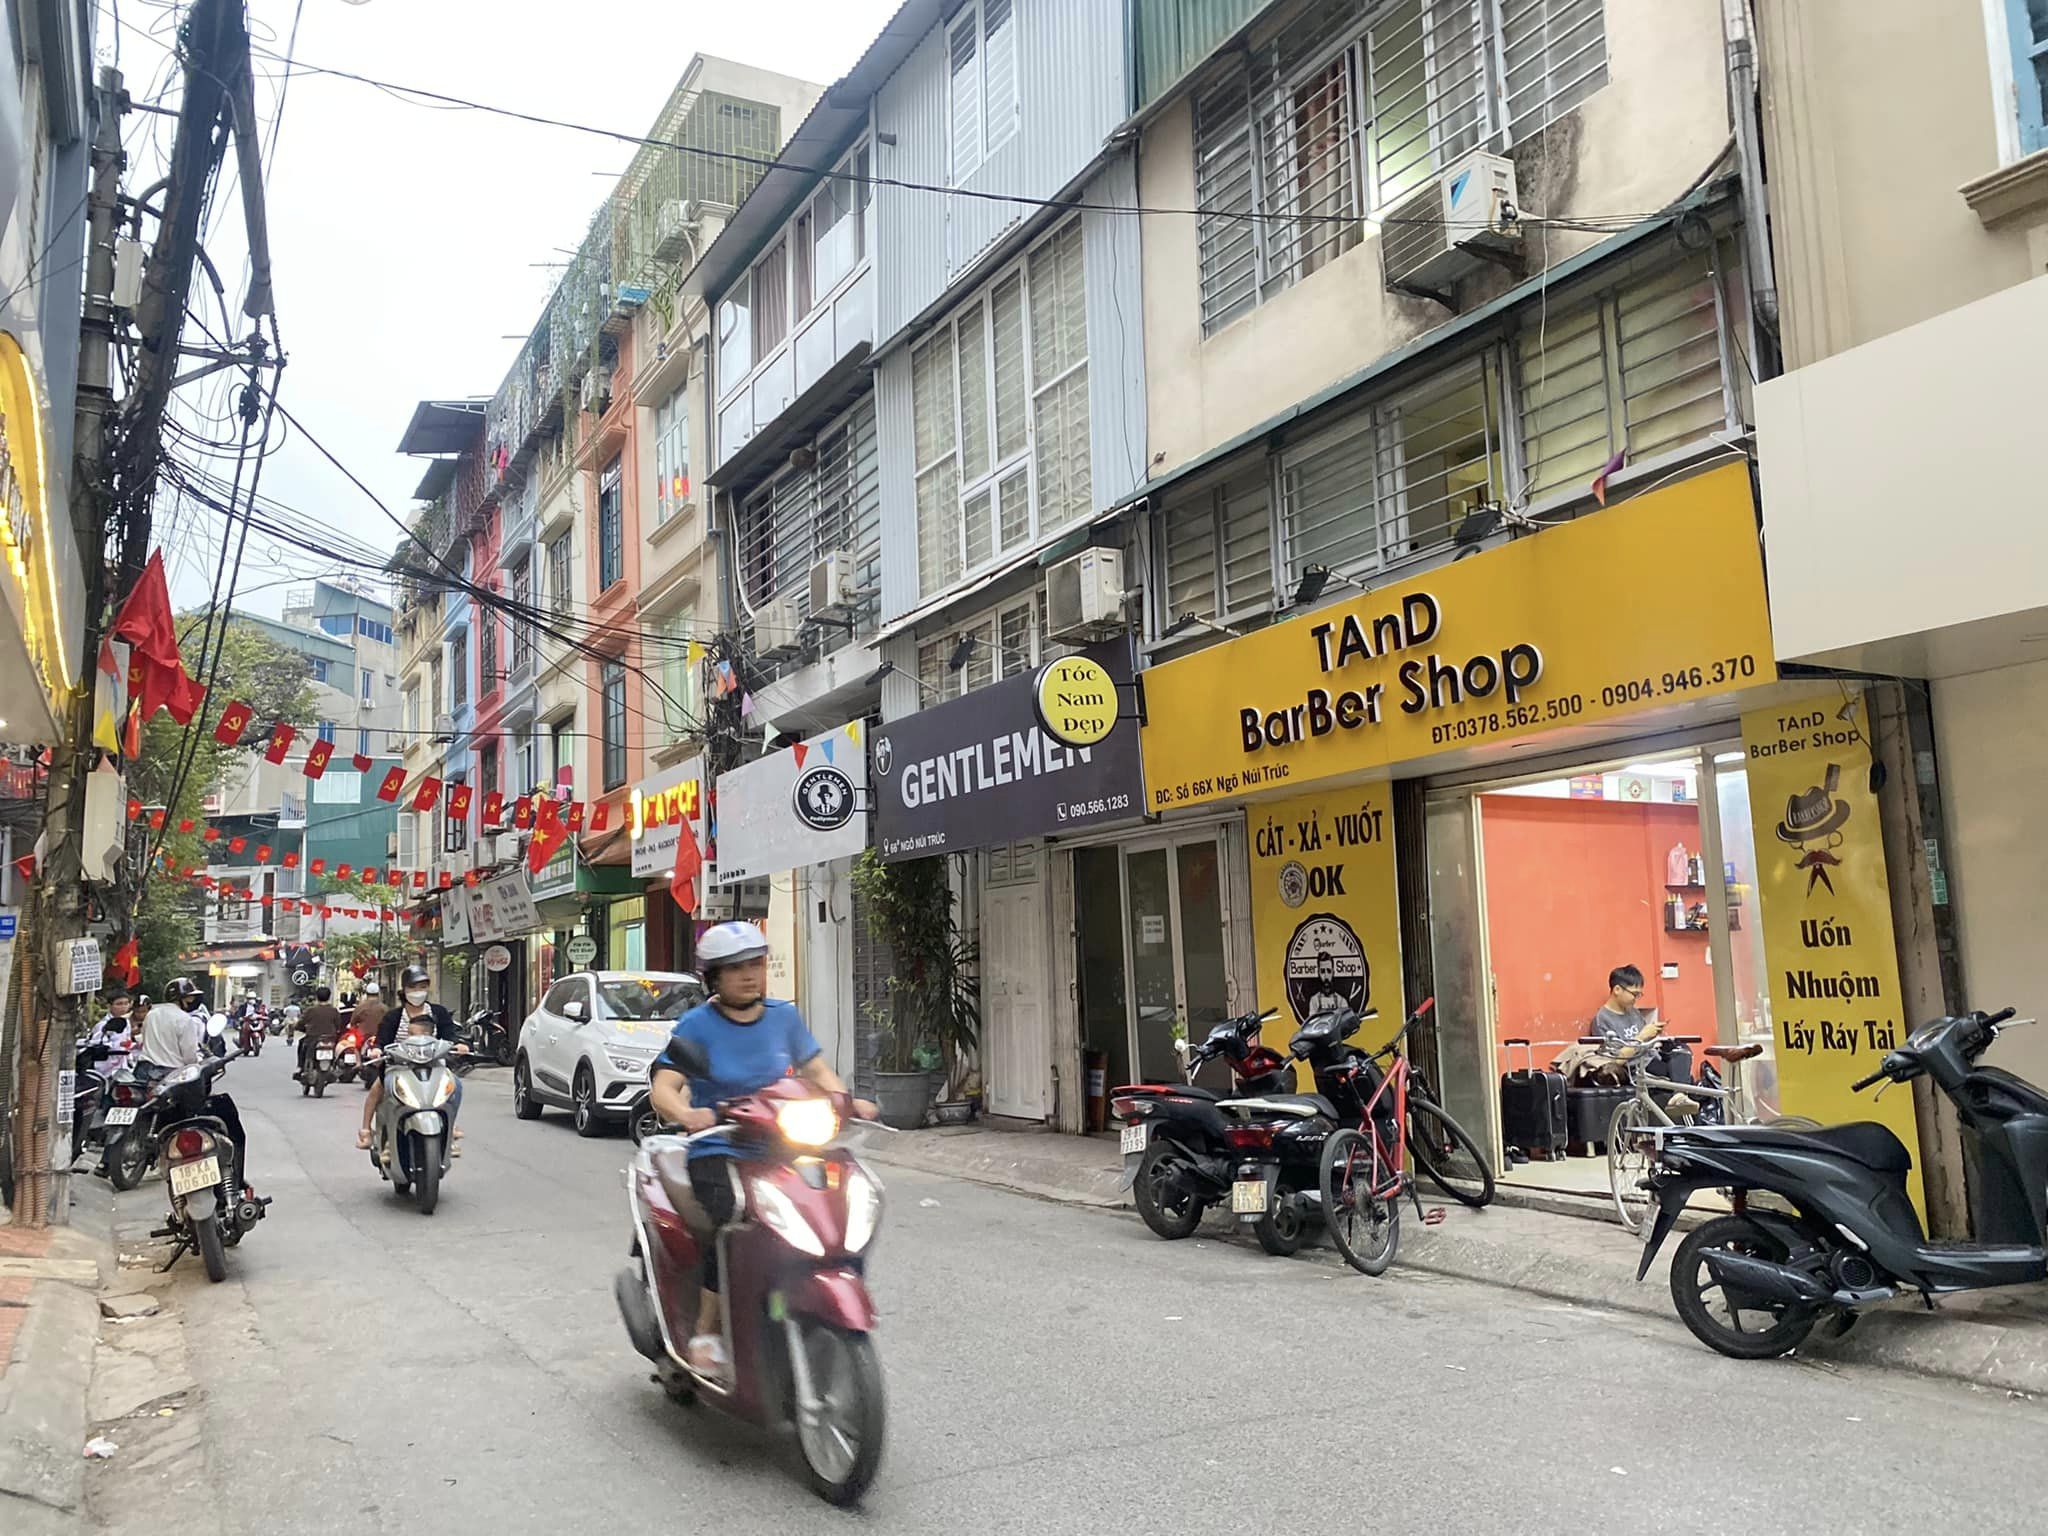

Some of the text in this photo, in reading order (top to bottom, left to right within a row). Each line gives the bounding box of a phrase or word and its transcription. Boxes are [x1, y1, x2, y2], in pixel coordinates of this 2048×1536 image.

[1311, 593, 1440, 672] TAnD
[1057, 666, 1097, 682] Tóc
[1601, 654, 1755, 708] 0904.946.370
[1057, 693, 1104, 707] Nam
[1240, 642, 1542, 753] BarBer Shop
[1063, 716, 1105, 734] Đẹp
[1777, 711, 1825, 733] TAnD
[1812, 728, 1860, 748] Shop
[1192, 779, 1213, 796] 66X
[1070, 794, 1129, 818] 090.566.1283
[1310, 864, 1347, 898] OK
[1800, 917, 1851, 948] Uốn
[1290, 960, 1357, 975] Barber Shop
[1785, 971, 1880, 1004] Nhuộm
[1783, 1019, 1895, 1056] Lấy Ráy Tai
